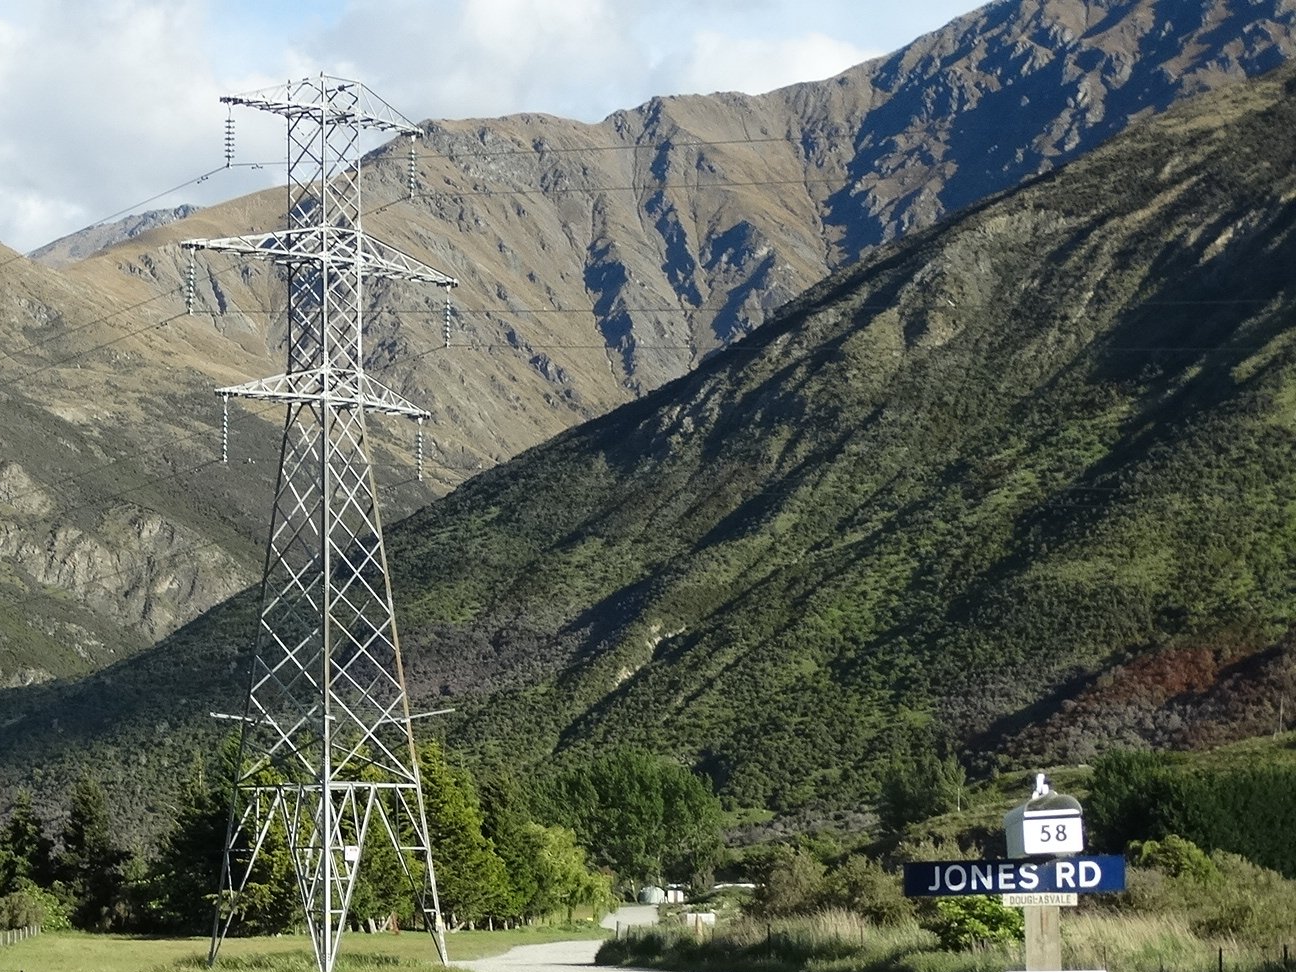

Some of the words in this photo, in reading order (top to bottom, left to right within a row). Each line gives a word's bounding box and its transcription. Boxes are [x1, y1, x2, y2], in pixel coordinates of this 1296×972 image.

[1040, 824, 1067, 842] 58
[928, 863, 1039, 891] JONES
[1056, 861, 1101, 888] RD
